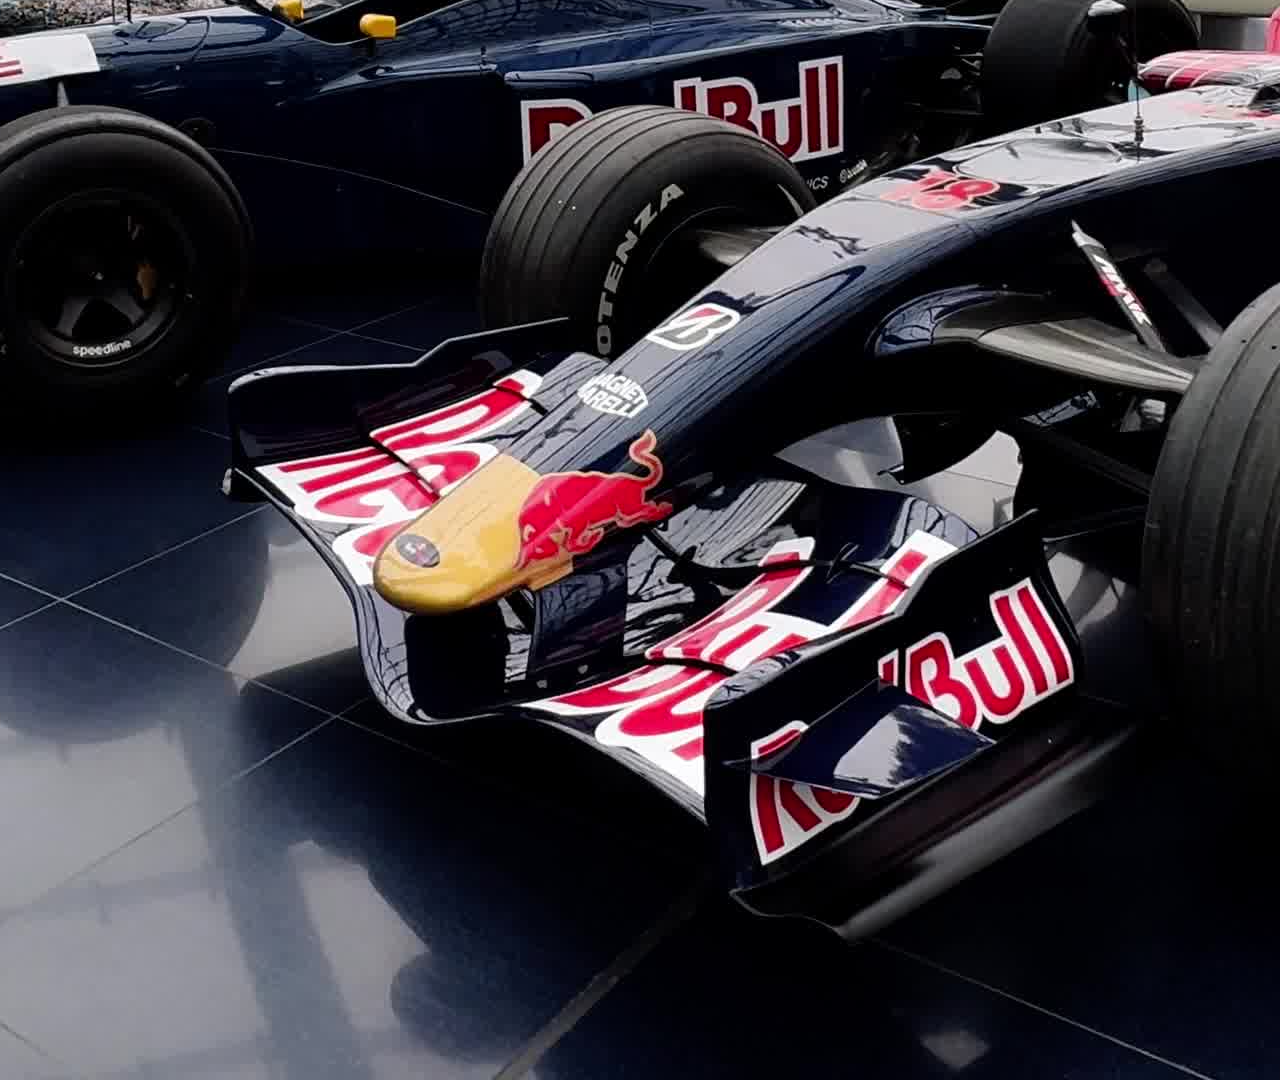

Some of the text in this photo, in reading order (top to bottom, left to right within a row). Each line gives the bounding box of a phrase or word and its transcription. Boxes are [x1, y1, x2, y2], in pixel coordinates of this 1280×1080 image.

[702, 55, 844, 163] Bull
[596, 183, 685, 356] OTENZA
[72, 340, 132, 358] speedline
[905, 576, 1074, 732] Bull
